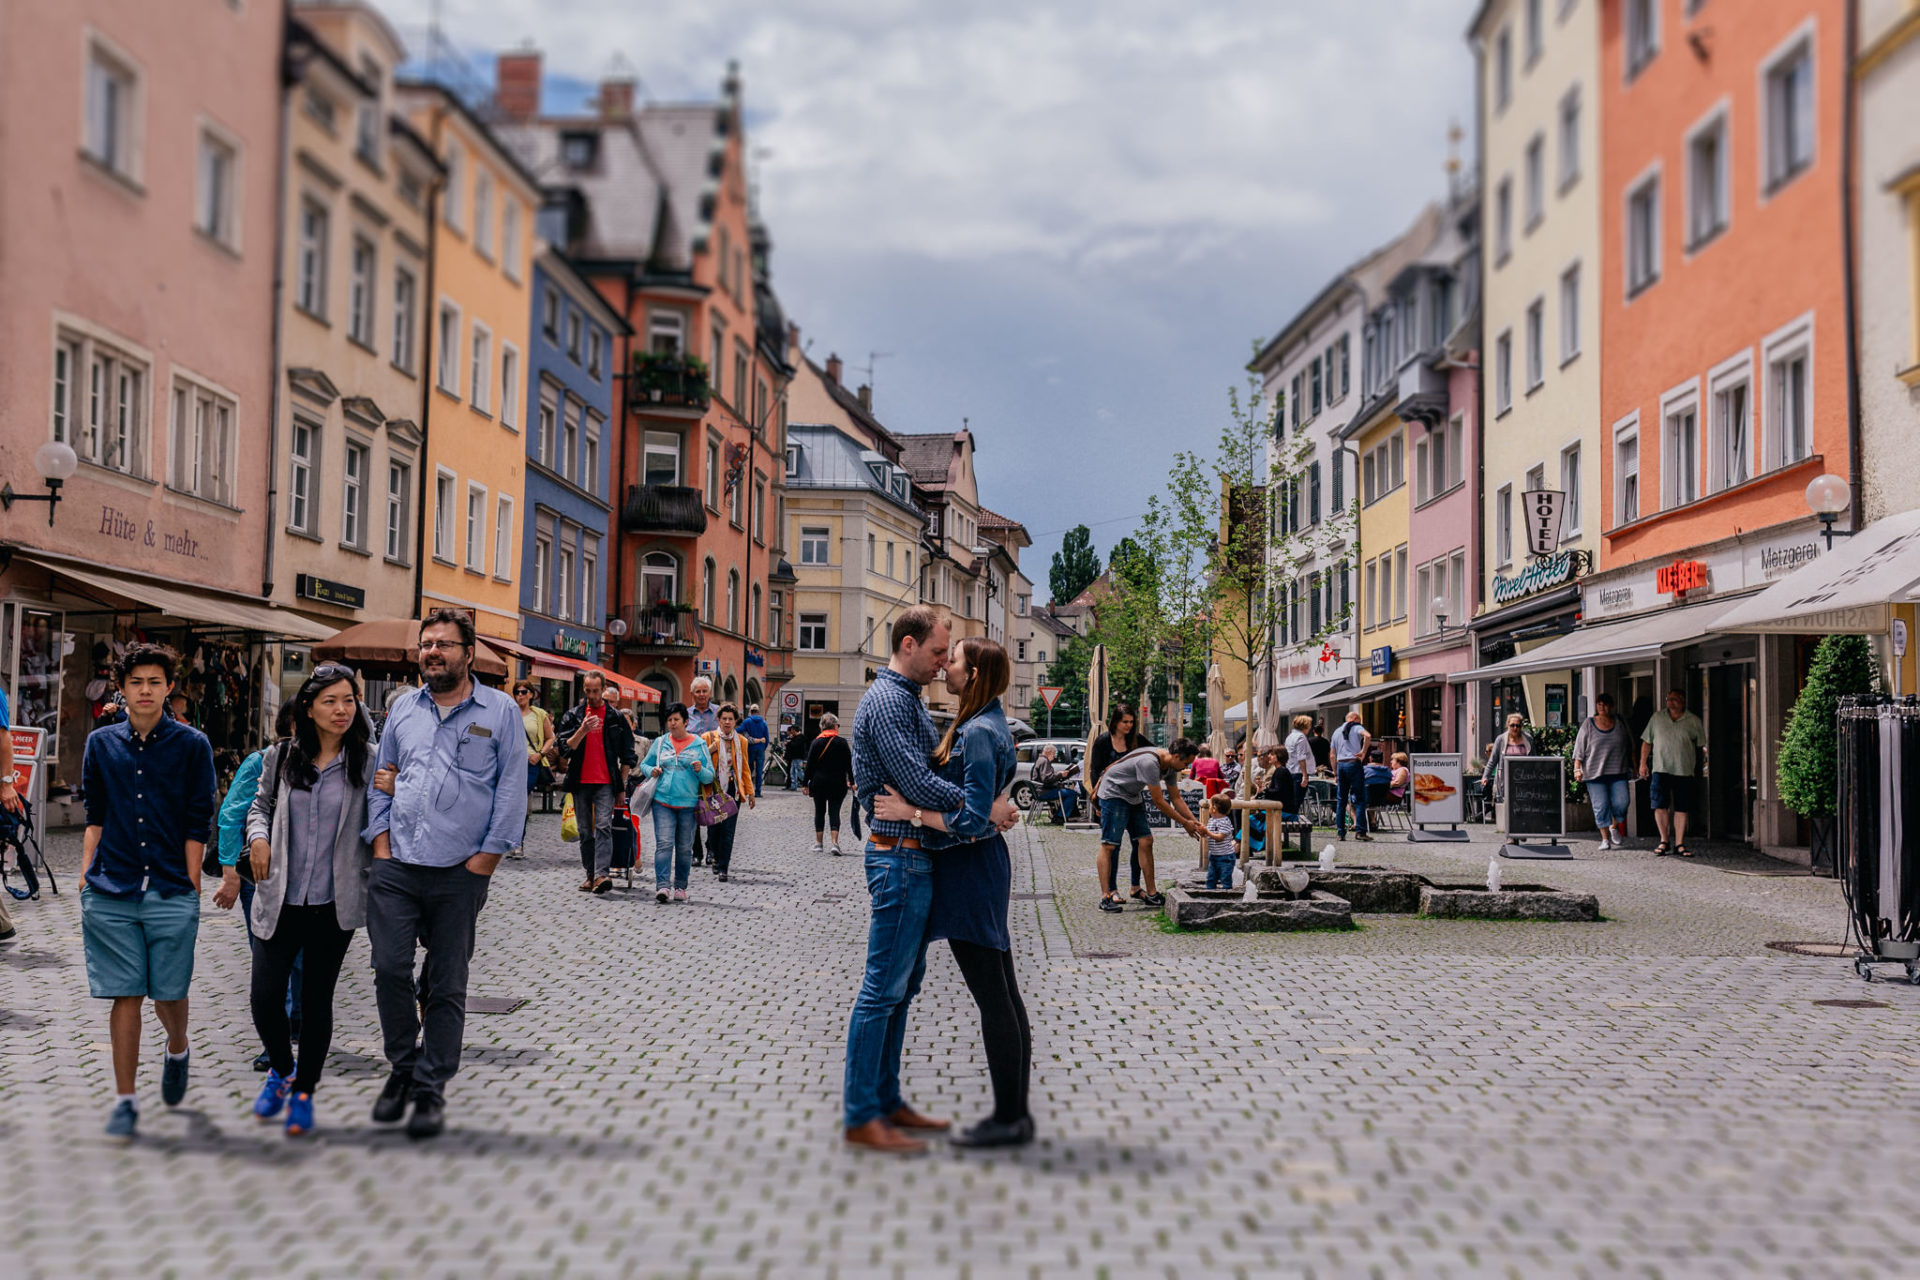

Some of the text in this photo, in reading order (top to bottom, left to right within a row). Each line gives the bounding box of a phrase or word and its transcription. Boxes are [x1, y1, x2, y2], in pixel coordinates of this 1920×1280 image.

[99, 505, 136, 541] Hüte
[144, 520, 156, 548] &
[1536, 494, 1553, 551] HOTEL
[1761, 542, 1818, 570] Metzgerei
[788, 696, 796, 704] 30
[1414, 759, 1458, 768] Rostbratwurst
